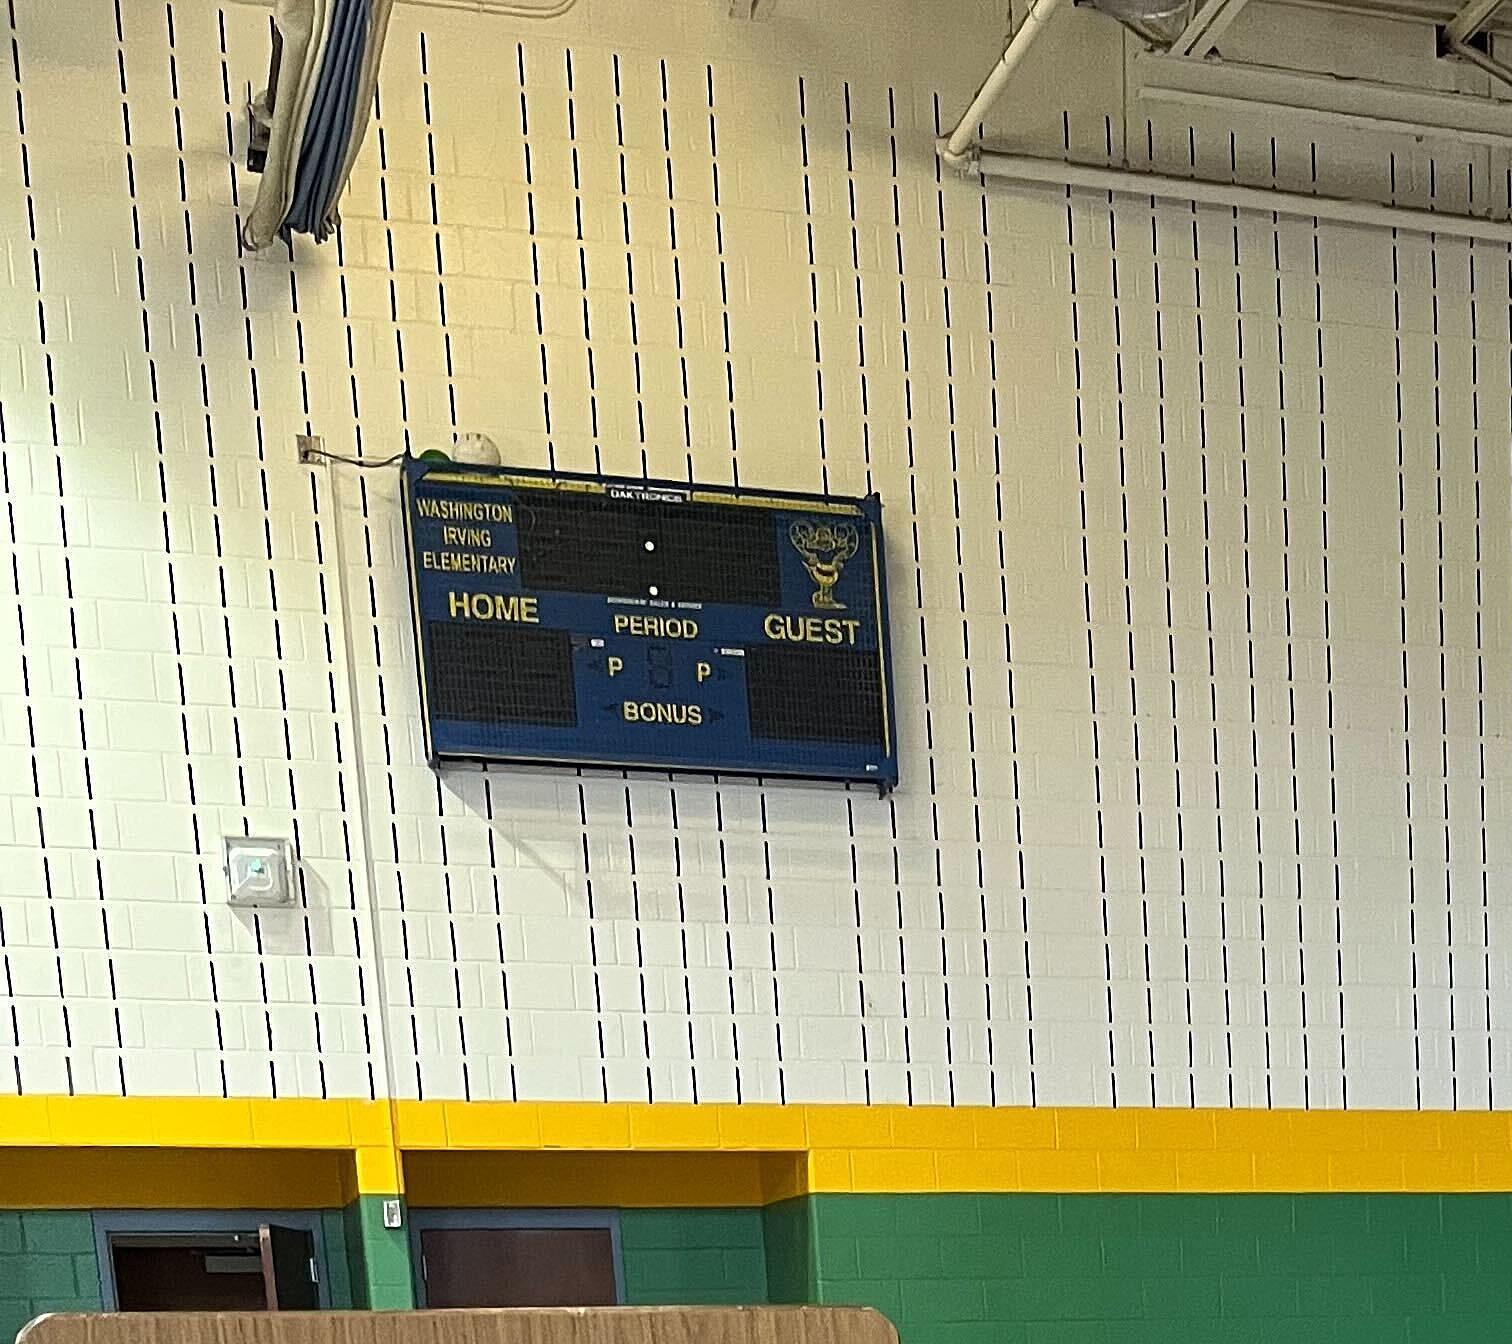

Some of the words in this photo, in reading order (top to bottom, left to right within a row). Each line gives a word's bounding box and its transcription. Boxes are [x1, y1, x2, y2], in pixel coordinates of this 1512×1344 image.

[416, 497, 513, 523] WASHINGTON
[443, 525, 492, 547] IRVING
[422, 550, 516, 574] ELEMENTARY
[448, 591, 539, 623] HOME
[614, 614, 699, 639] PERIOD
[763, 612, 861, 645] GUEST
[607, 656, 623, 677] P
[696, 661, 712, 683] P
[623, 701, 703, 726] BONUS
